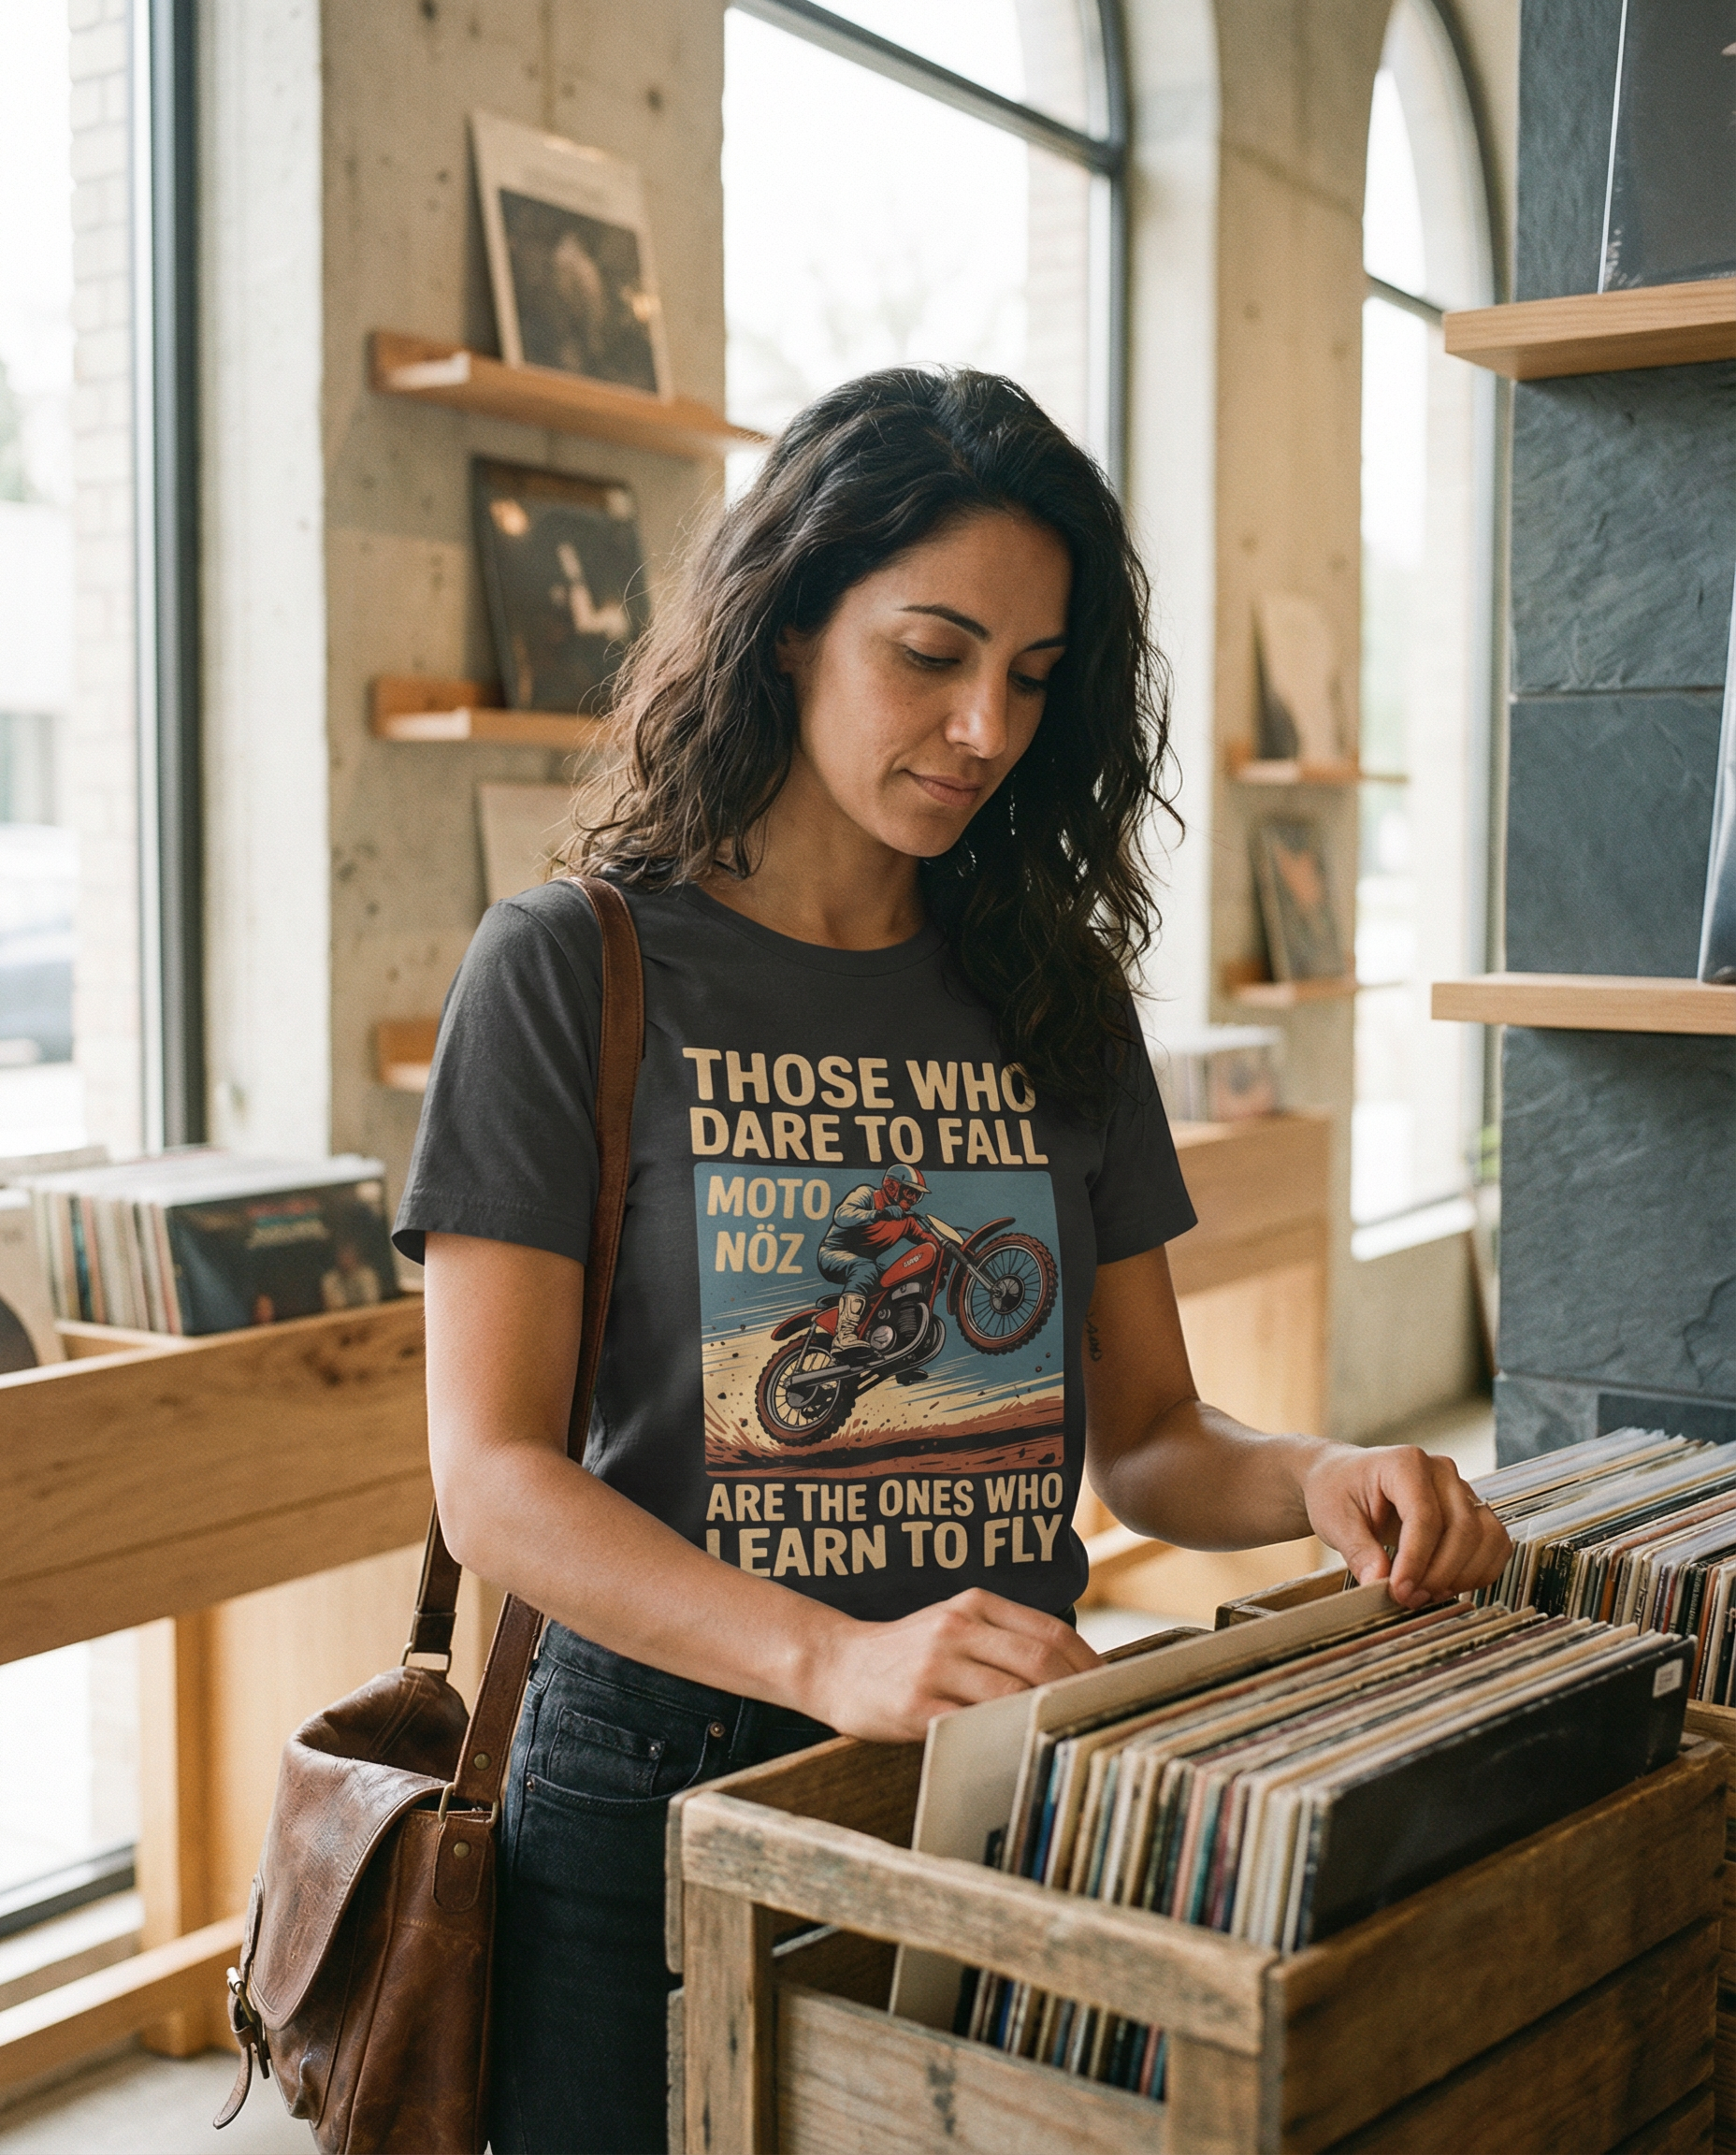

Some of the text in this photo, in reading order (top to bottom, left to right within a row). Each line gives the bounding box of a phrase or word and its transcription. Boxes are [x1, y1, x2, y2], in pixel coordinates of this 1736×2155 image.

[682, 1047, 1036, 1113] THOSE WHO
[689, 1106, 1049, 1165] DARE TO FALL
[706, 1175, 832, 1221] MOTO
[715, 1223, 805, 1275] NÖZ
[705, 1471, 1064, 1523] ARE THE ONES WHO
[901, 1521, 969, 1569] TO
[984, 1513, 1064, 1568] FLY
